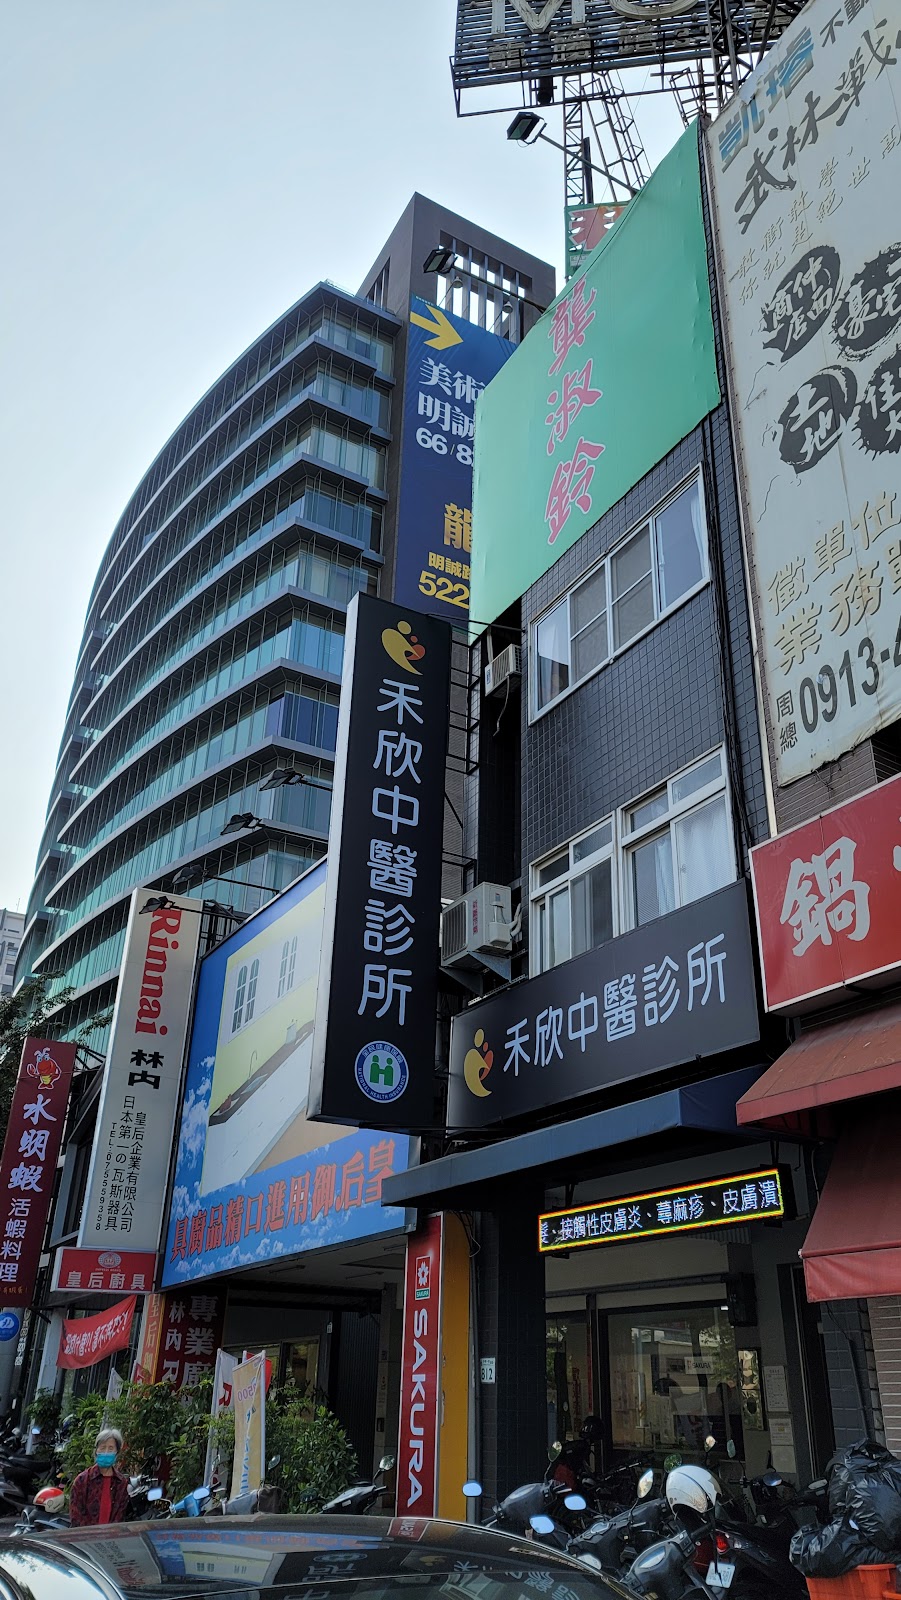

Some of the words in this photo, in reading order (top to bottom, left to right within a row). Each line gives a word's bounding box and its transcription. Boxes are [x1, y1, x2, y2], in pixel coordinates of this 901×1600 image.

[733, 17, 901, 236] 武林戰
[415, 427, 475, 468] 66/8
[357, 677, 424, 1027] 禾欣中醫診所
[780, 836, 901, 957] 鍋
[135, 907, 182, 1036] Rinnai
[502, 932, 727, 1077] 禾欣中醫診所
[104, 1095, 136, 1232] 日本第一の瓦斯器具
[120, 1111, 147, 1233] 皇后企業有限公司
[0, 1197, 31, 1283] 活蝦料理
[66, 1270, 145, 1290] 皇后廚具
[407, 1307, 428, 1508] SAKURA
